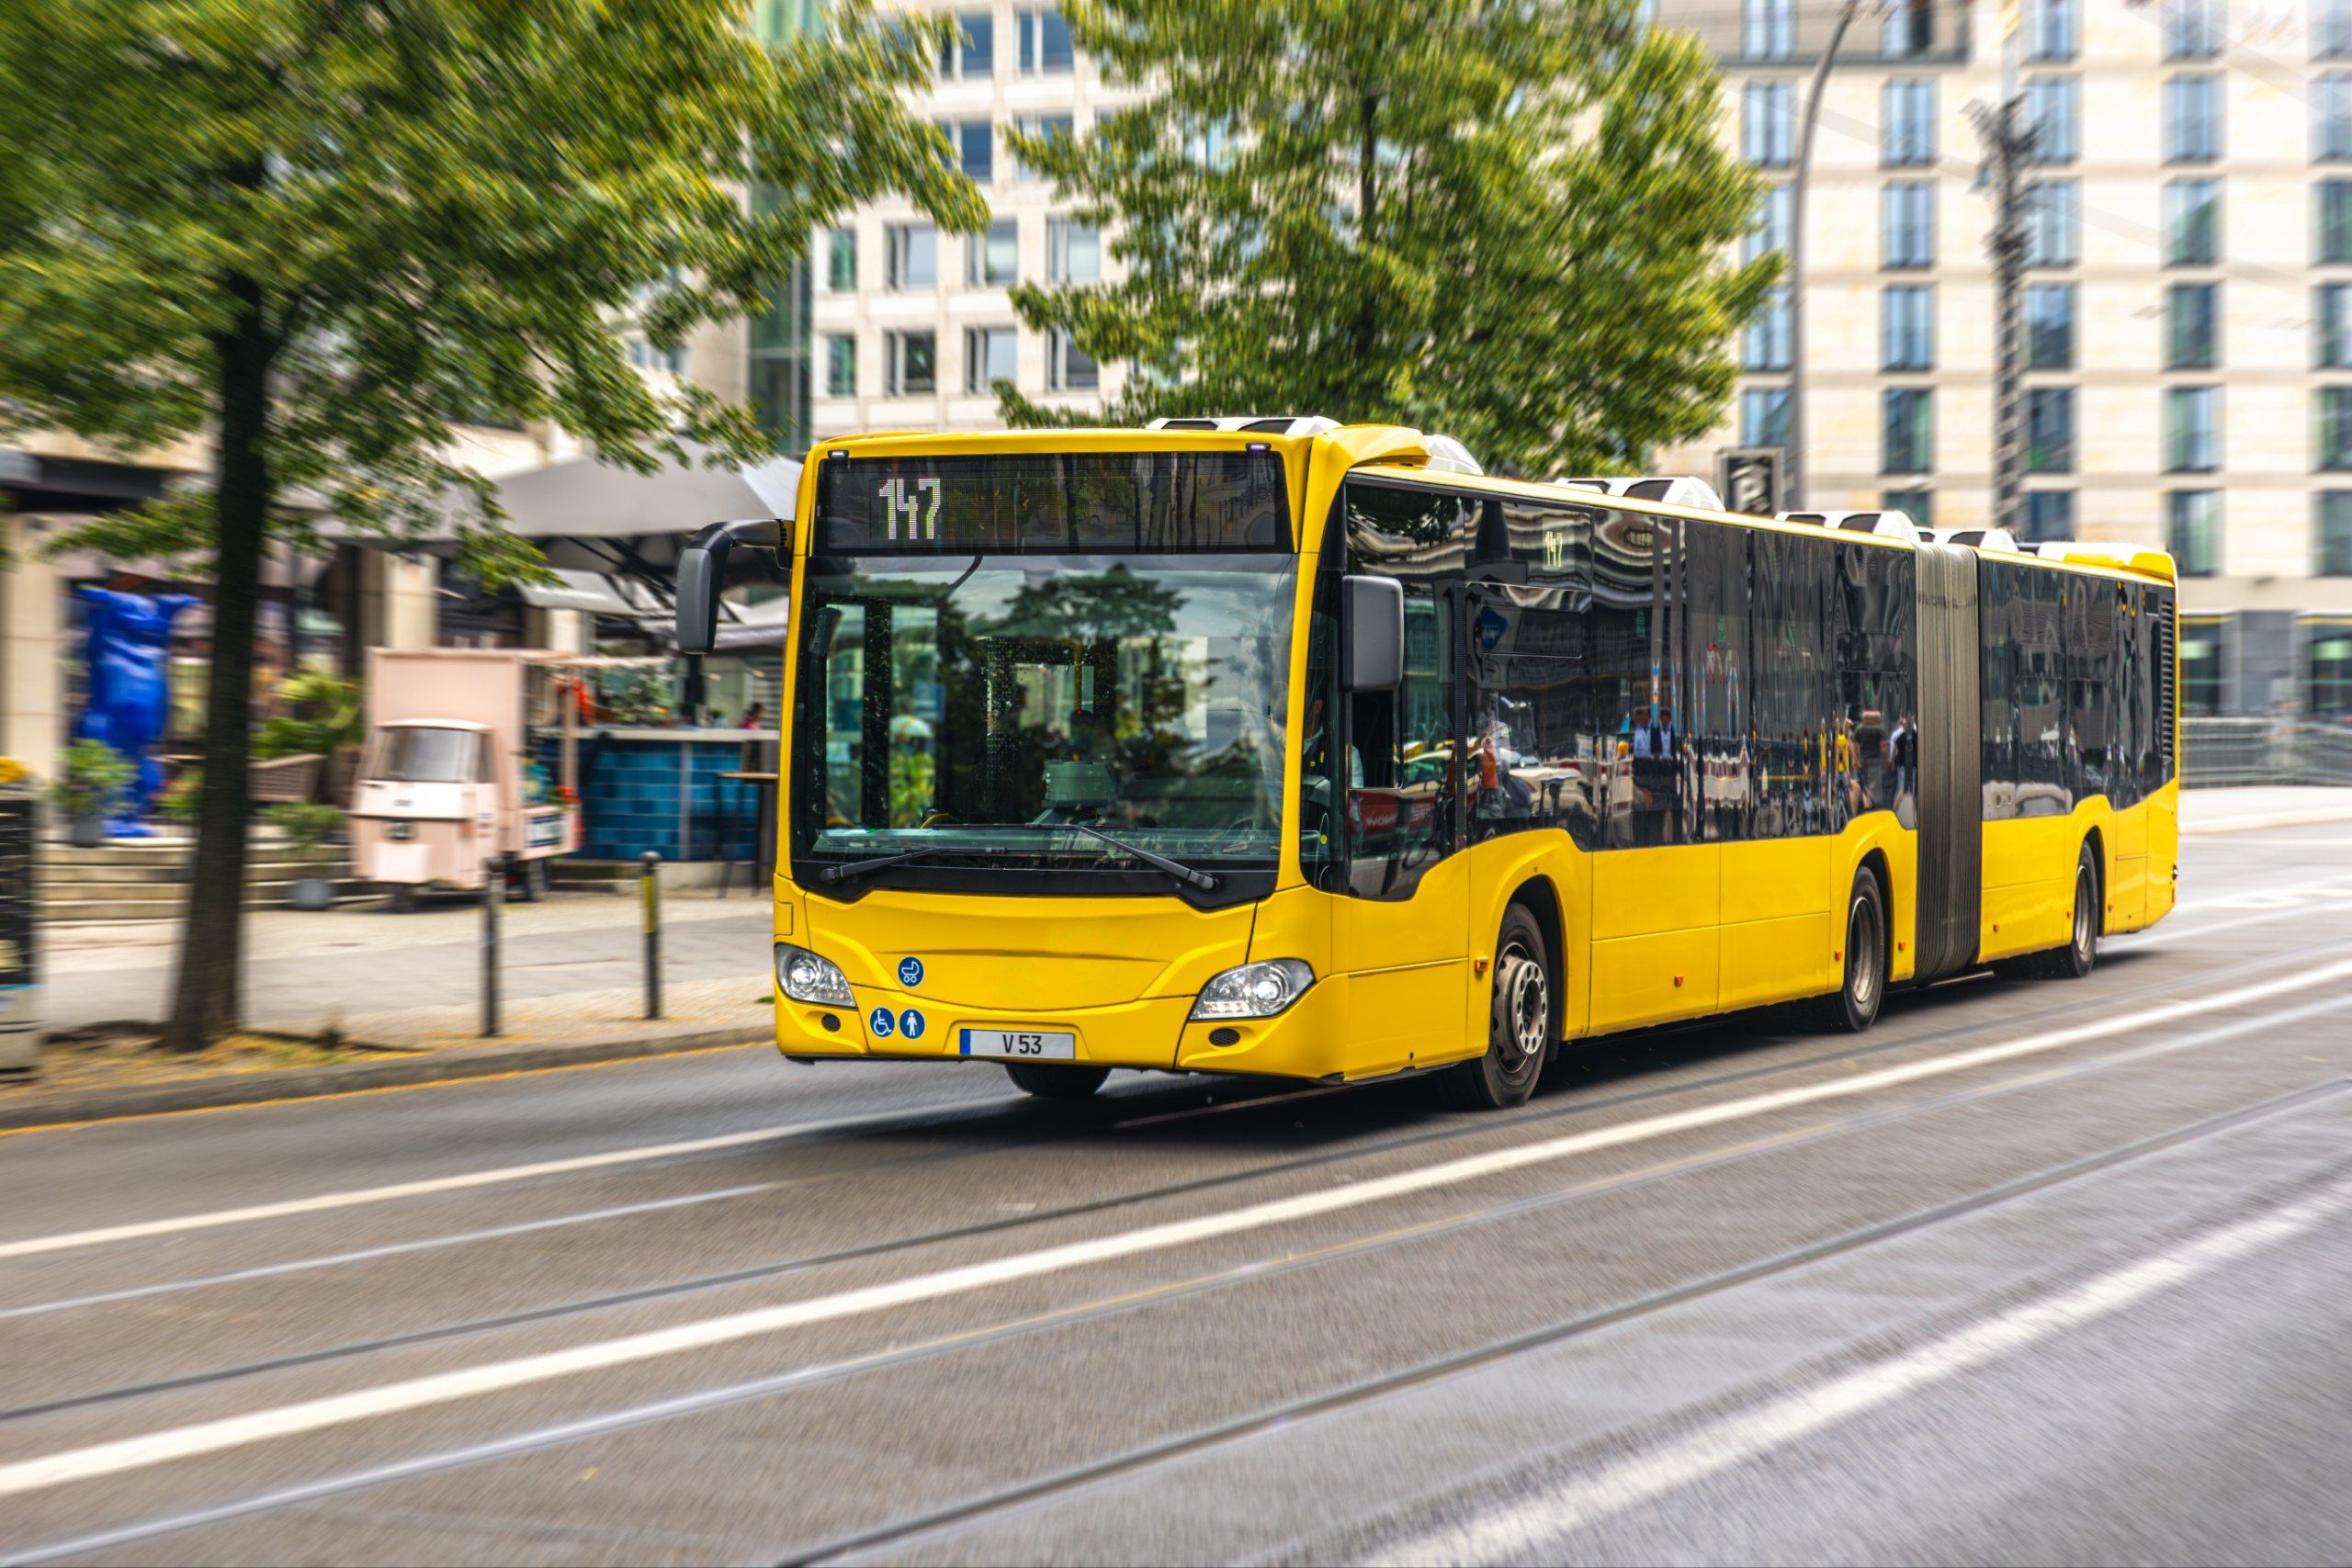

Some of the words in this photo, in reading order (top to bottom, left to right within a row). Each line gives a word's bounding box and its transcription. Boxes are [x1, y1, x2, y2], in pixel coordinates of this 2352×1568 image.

[879, 479, 941, 540] 147
[1545, 531, 1563, 568] 147
[1002, 1033, 1014, 1054] V
[1018, 1034, 1042, 1055] 53
